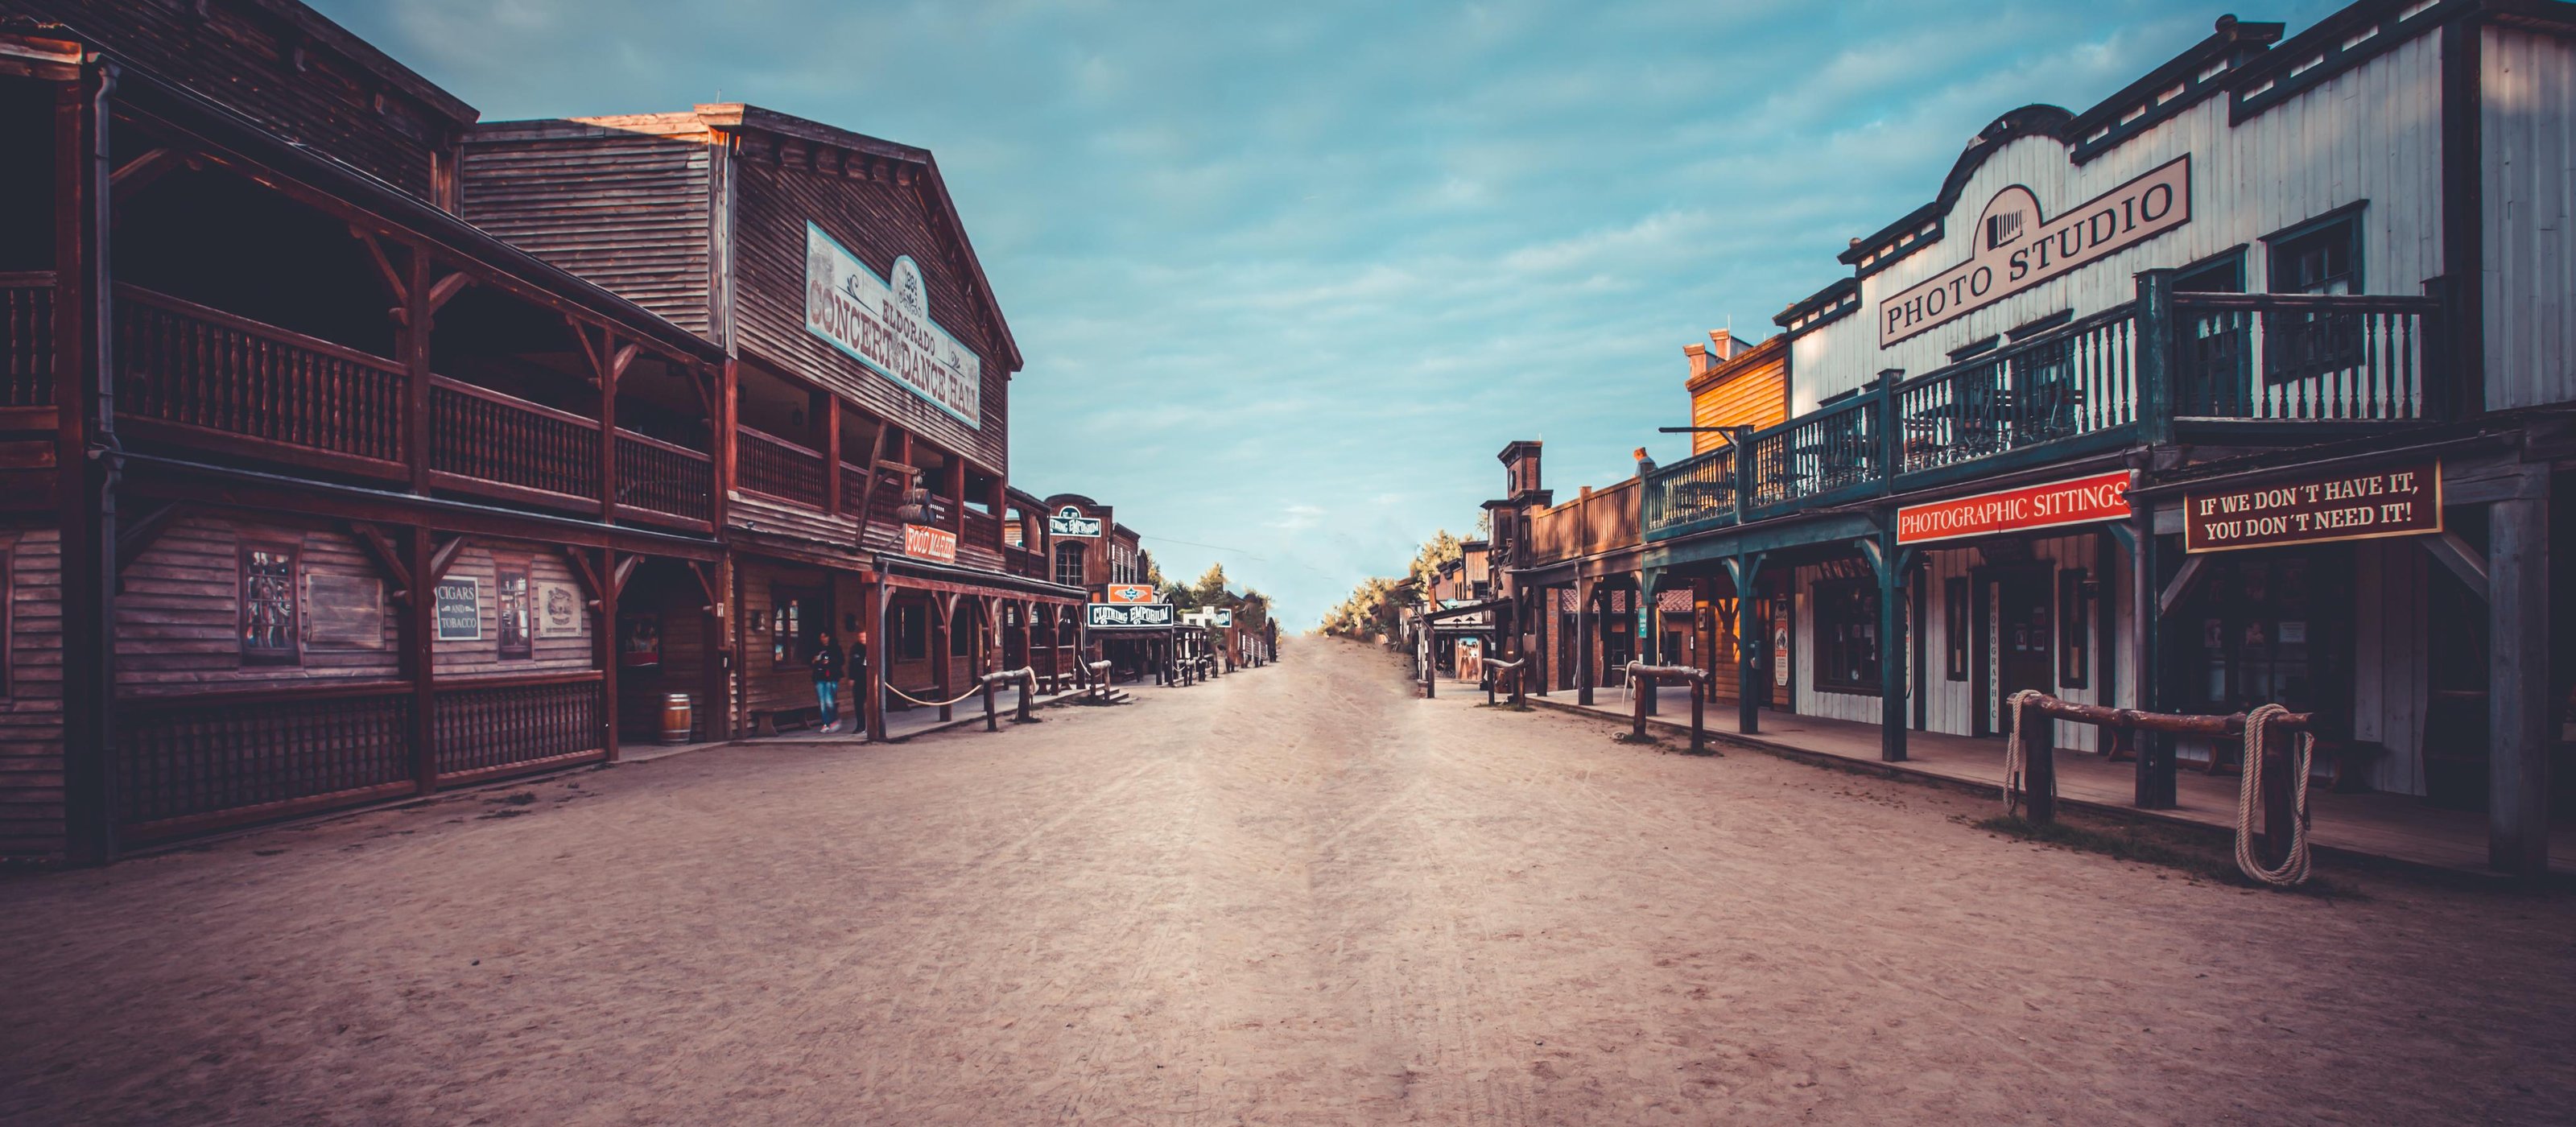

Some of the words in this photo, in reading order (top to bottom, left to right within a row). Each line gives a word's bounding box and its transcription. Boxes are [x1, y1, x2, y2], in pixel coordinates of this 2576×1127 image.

[1888, 266, 1992, 335] PHOTO
[2009, 183, 2173, 283] STUDIO
[905, 269, 917, 296] 1884
[882, 299, 935, 356] ELDORADO
[811, 279, 892, 370] CONCERT
[901, 341, 946, 403] DANCE
[949, 374, 978, 423] HALL
[1901, 497, 2028, 535] PHOTOGRAPHIC
[2033, 481, 2129, 517] SITTINGS
[2200, 498, 2216, 516] IF
[2220, 493, 2250, 514] WE
[2324, 475, 2383, 501] HAVE
[2389, 472, 2418, 495] IT,
[2205, 521, 2241, 540] YOU
[2314, 506, 2374, 530] NEED
[2380, 502, 2412, 523] IT!
[907, 527, 930, 554] FOOD
[438, 586, 475, 601] CIGARS
[451, 605, 465, 613] AND
[441, 617, 477, 629] TOBACCO
[1093, 606, 1128, 624] CLOTHING
[1129, 605, 1168, 622] EMPORIUM
